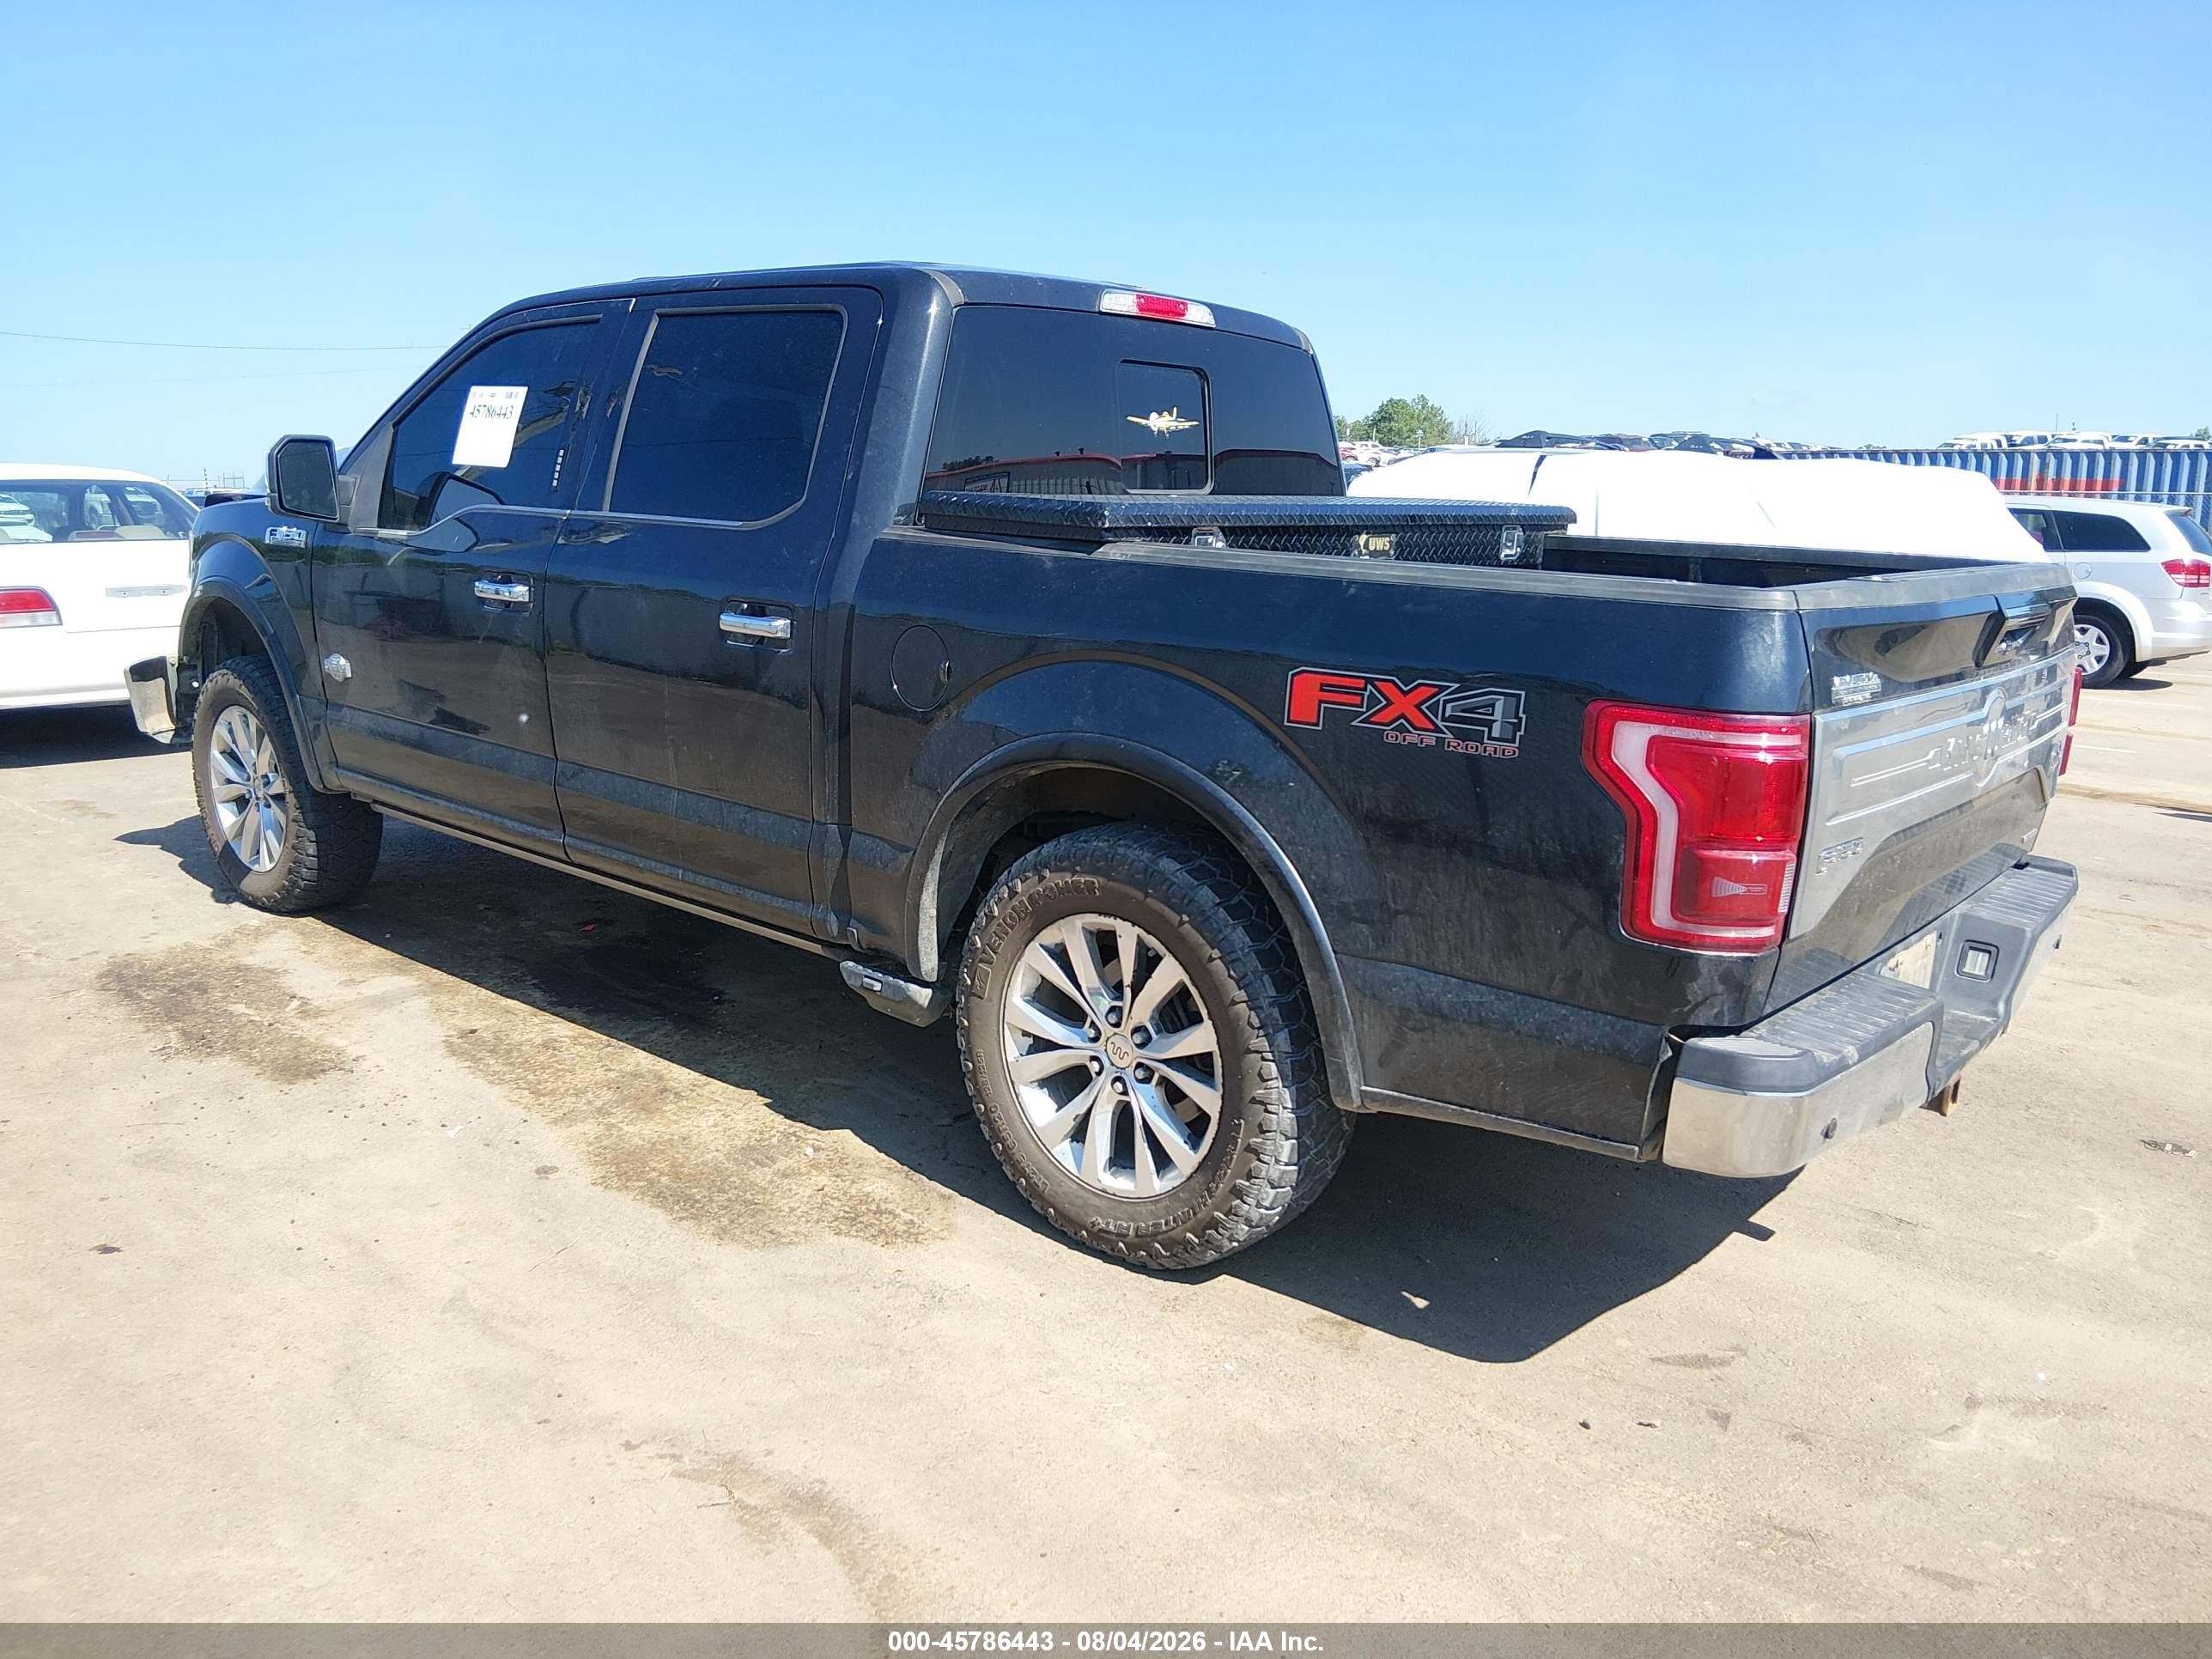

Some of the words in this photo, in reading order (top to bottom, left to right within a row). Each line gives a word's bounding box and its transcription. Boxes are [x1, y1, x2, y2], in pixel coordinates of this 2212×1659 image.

[469, 404, 514, 419] 45786443
[1369, 537, 1390, 550] UWS
[1284, 666, 1526, 747] FX4
[1382, 730, 1437, 748] OFF
[1443, 738, 1520, 759] ROAD
